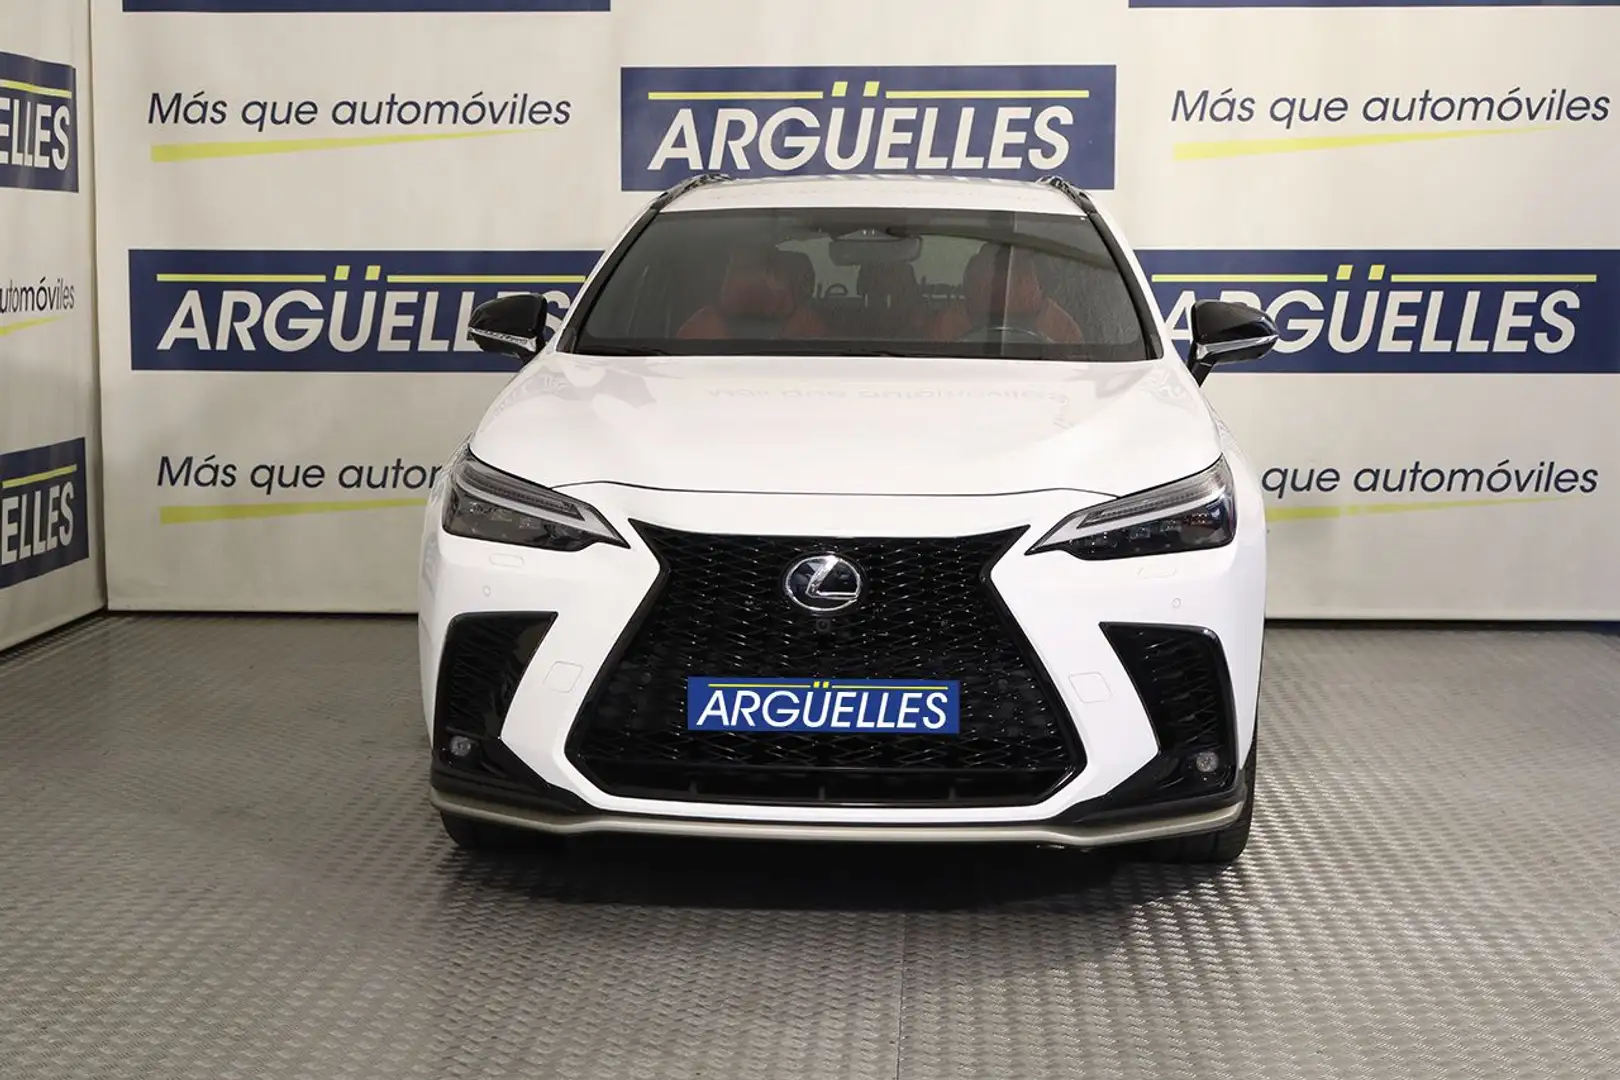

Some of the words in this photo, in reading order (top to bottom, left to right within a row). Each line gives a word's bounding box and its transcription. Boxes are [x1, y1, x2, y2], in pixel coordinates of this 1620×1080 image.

[148, 90, 228, 125] Más
[241, 100, 318, 133] que
[331, 91, 571, 125] automóviles
[647, 81, 1074, 170] ARGÜELLES
[1172, 88, 1255, 122] Más
[1270, 97, 1348, 129] que
[1362, 87, 1610, 122] automóviles
[157, 265, 572, 352] ARGÜELL
[1165, 264, 1580, 353] AGÜELLES
[156, 454, 238, 488] Más
[250, 464, 326, 496] que
[1261, 467, 1341, 499] que
[1353, 460, 1599, 493] automóviles
[2, 481, 74, 565] ELLES
[696, 681, 949, 729] ARGÜELLES
